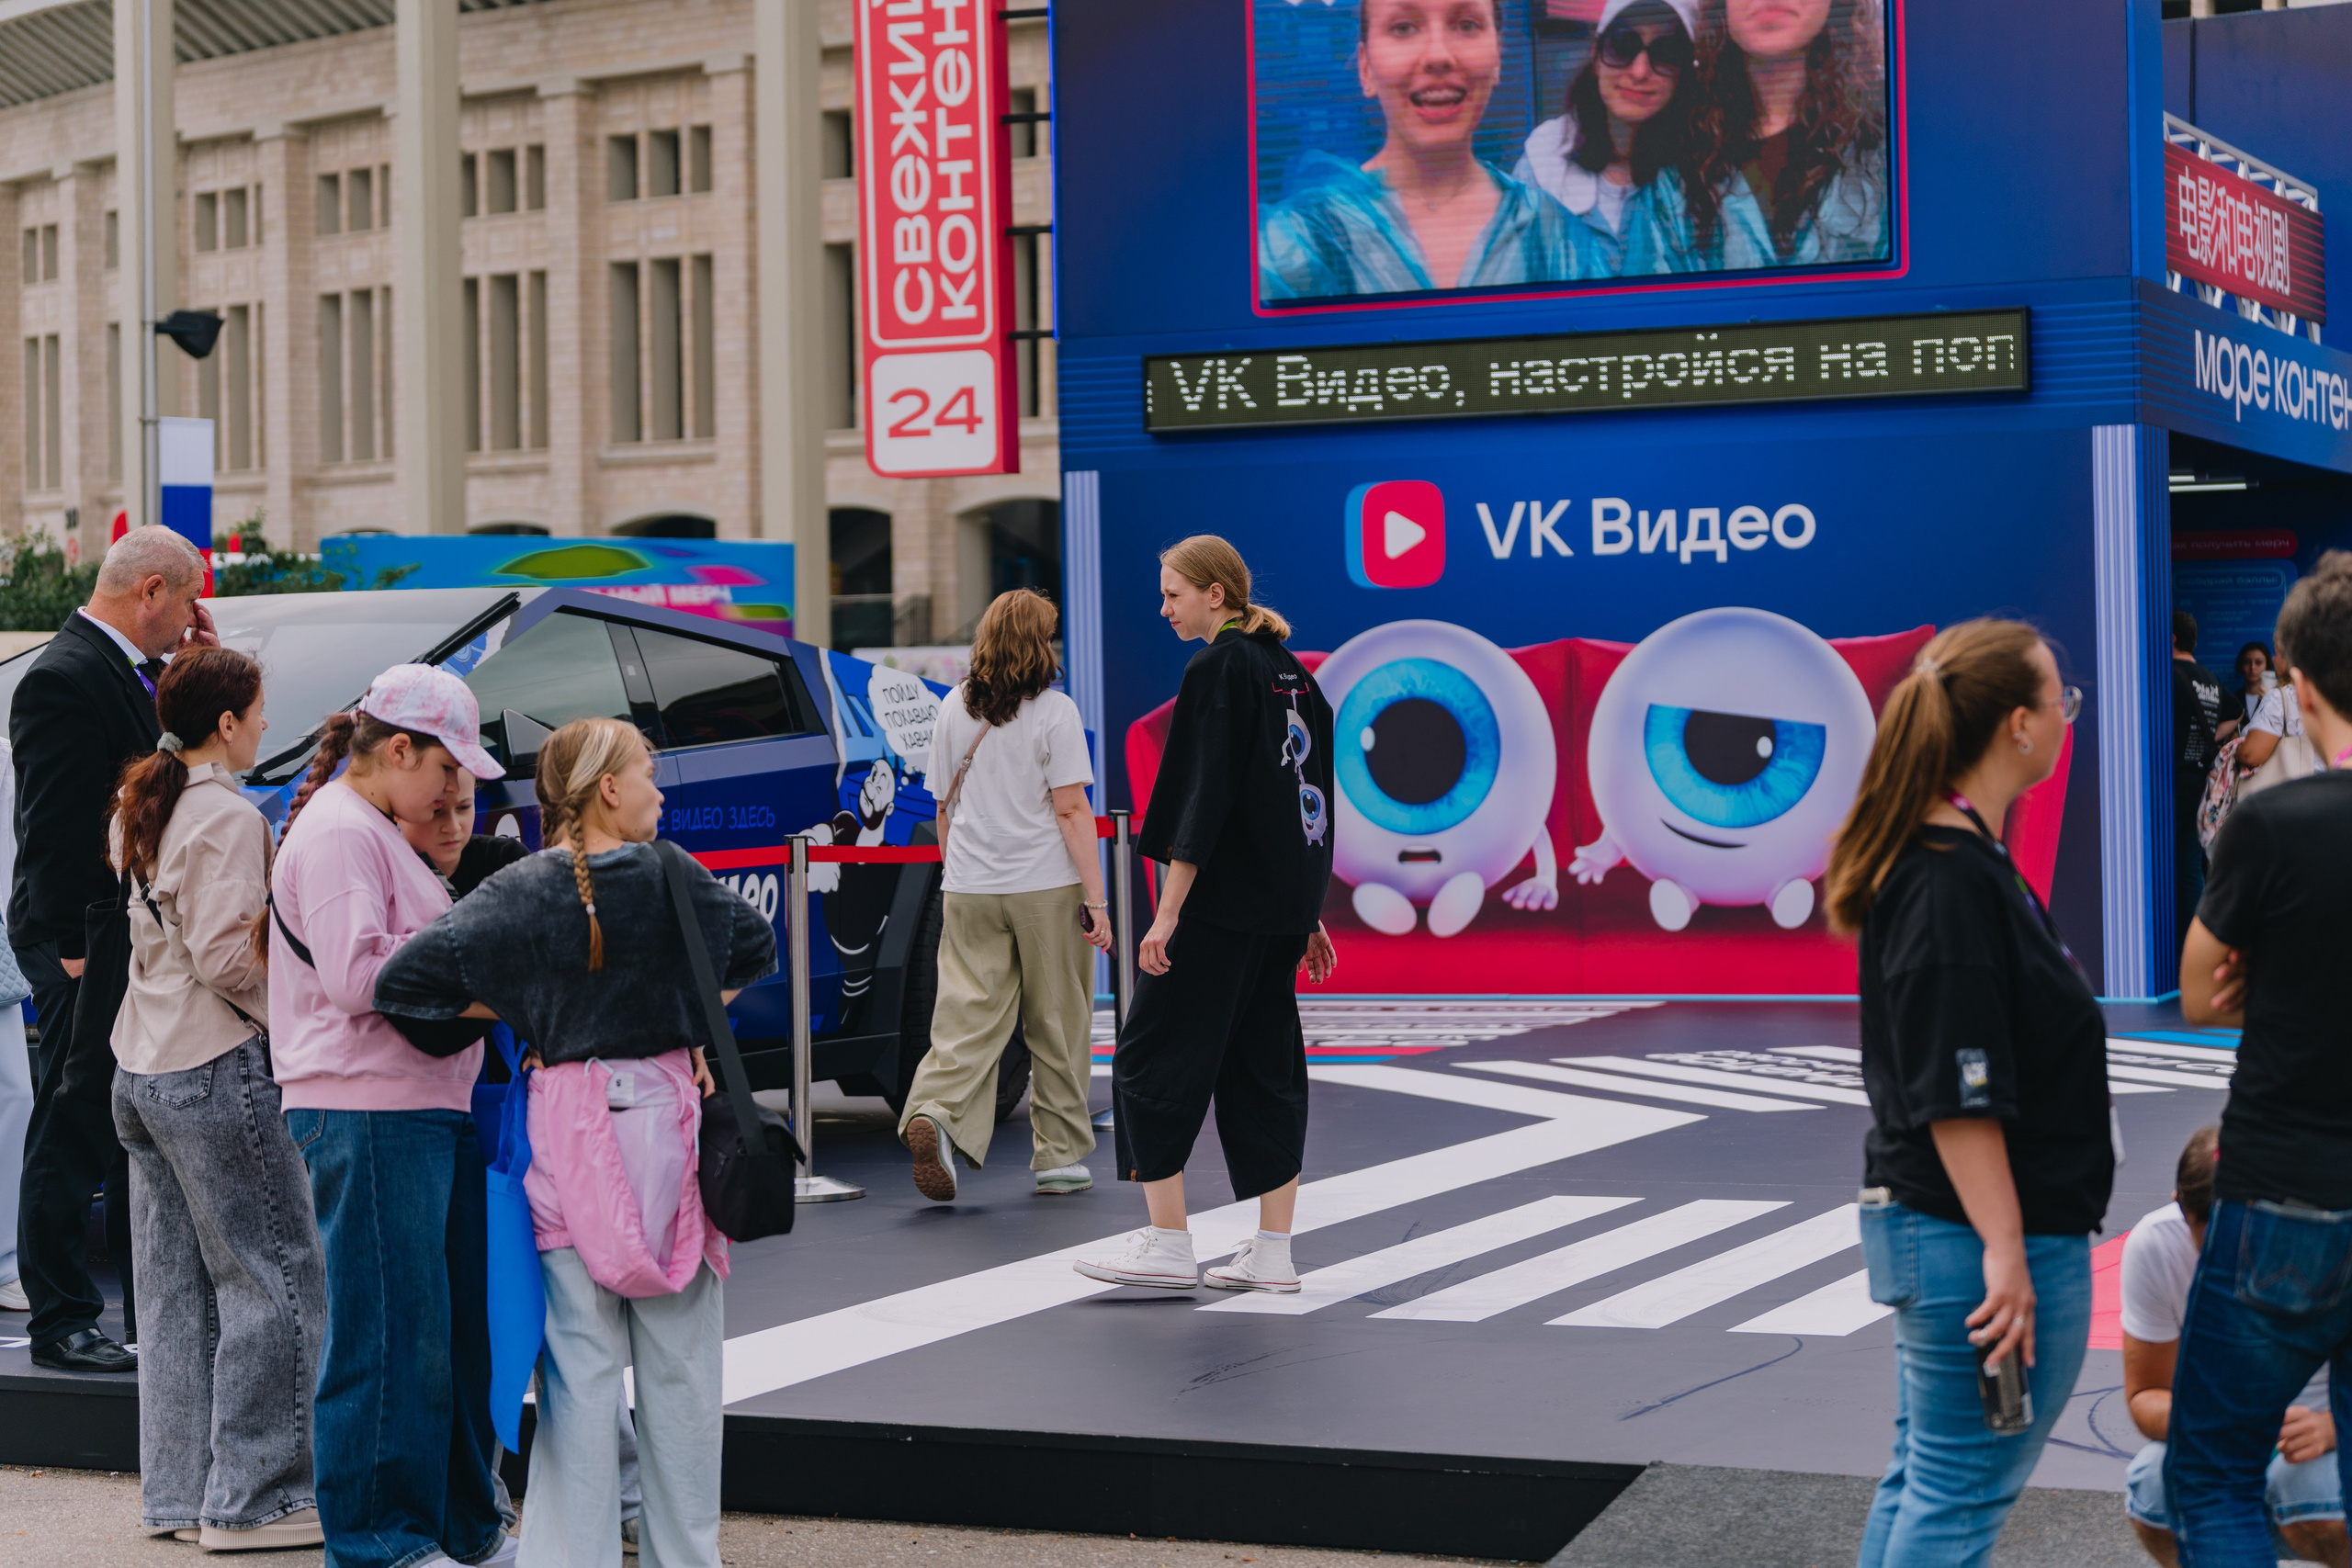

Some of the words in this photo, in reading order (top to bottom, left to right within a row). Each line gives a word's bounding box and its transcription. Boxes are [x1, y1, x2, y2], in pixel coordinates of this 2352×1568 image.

[2177, 165, 2291, 297] 电影和电视剧
[1170, 357, 1258, 411] VK
[1276, 355, 1464, 412] Видео,
[1488, 333, 1795, 398] настройся
[1820, 341, 1888, 378] на
[2194, 328, 2271, 423] Море
[887, 386, 983, 439] 24
[1476, 499, 1574, 558] VK
[1590, 496, 1817, 563] Видео
[2255, 538, 2290, 550] мерч
[882, 683, 919, 705] ПОЙДУ
[885, 705, 938, 728] ПОХАВАЮ
[671, 807, 724, 831] ВИДЕО
[728, 805, 776, 829] ЗДЕСЬ
